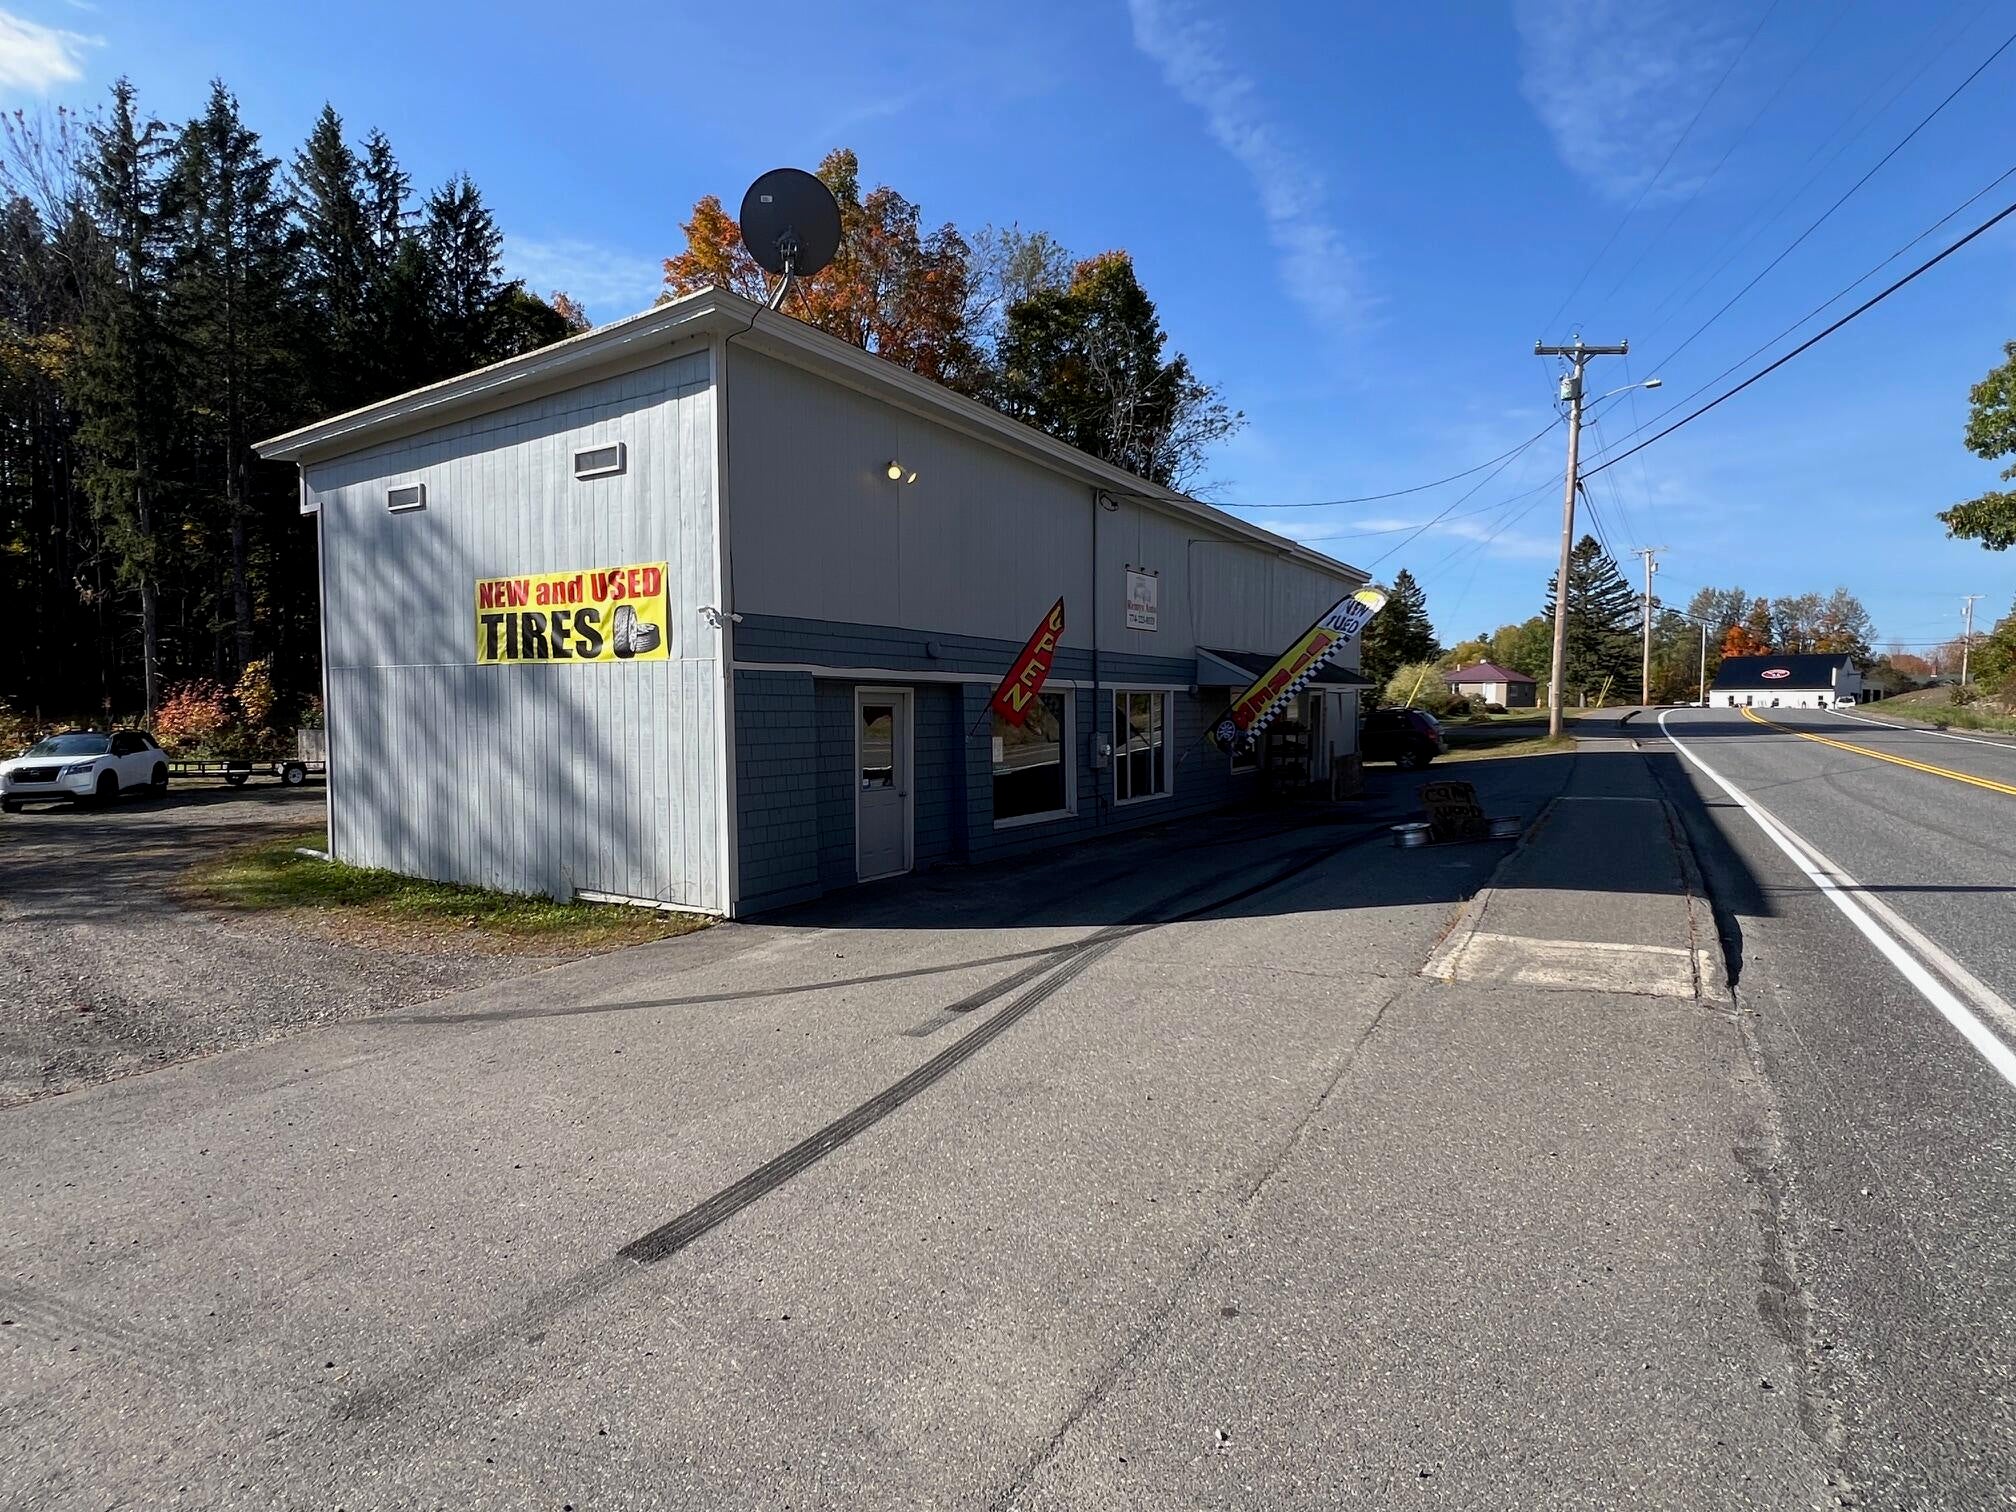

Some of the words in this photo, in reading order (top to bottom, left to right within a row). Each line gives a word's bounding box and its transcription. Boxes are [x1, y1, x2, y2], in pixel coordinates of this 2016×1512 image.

[479, 579, 529, 609] NEW
[536, 575, 583, 606] and
[591, 567, 661, 602] USED
[481, 608, 604, 659] TIRES
[1232, 633, 1333, 729] TIRES
